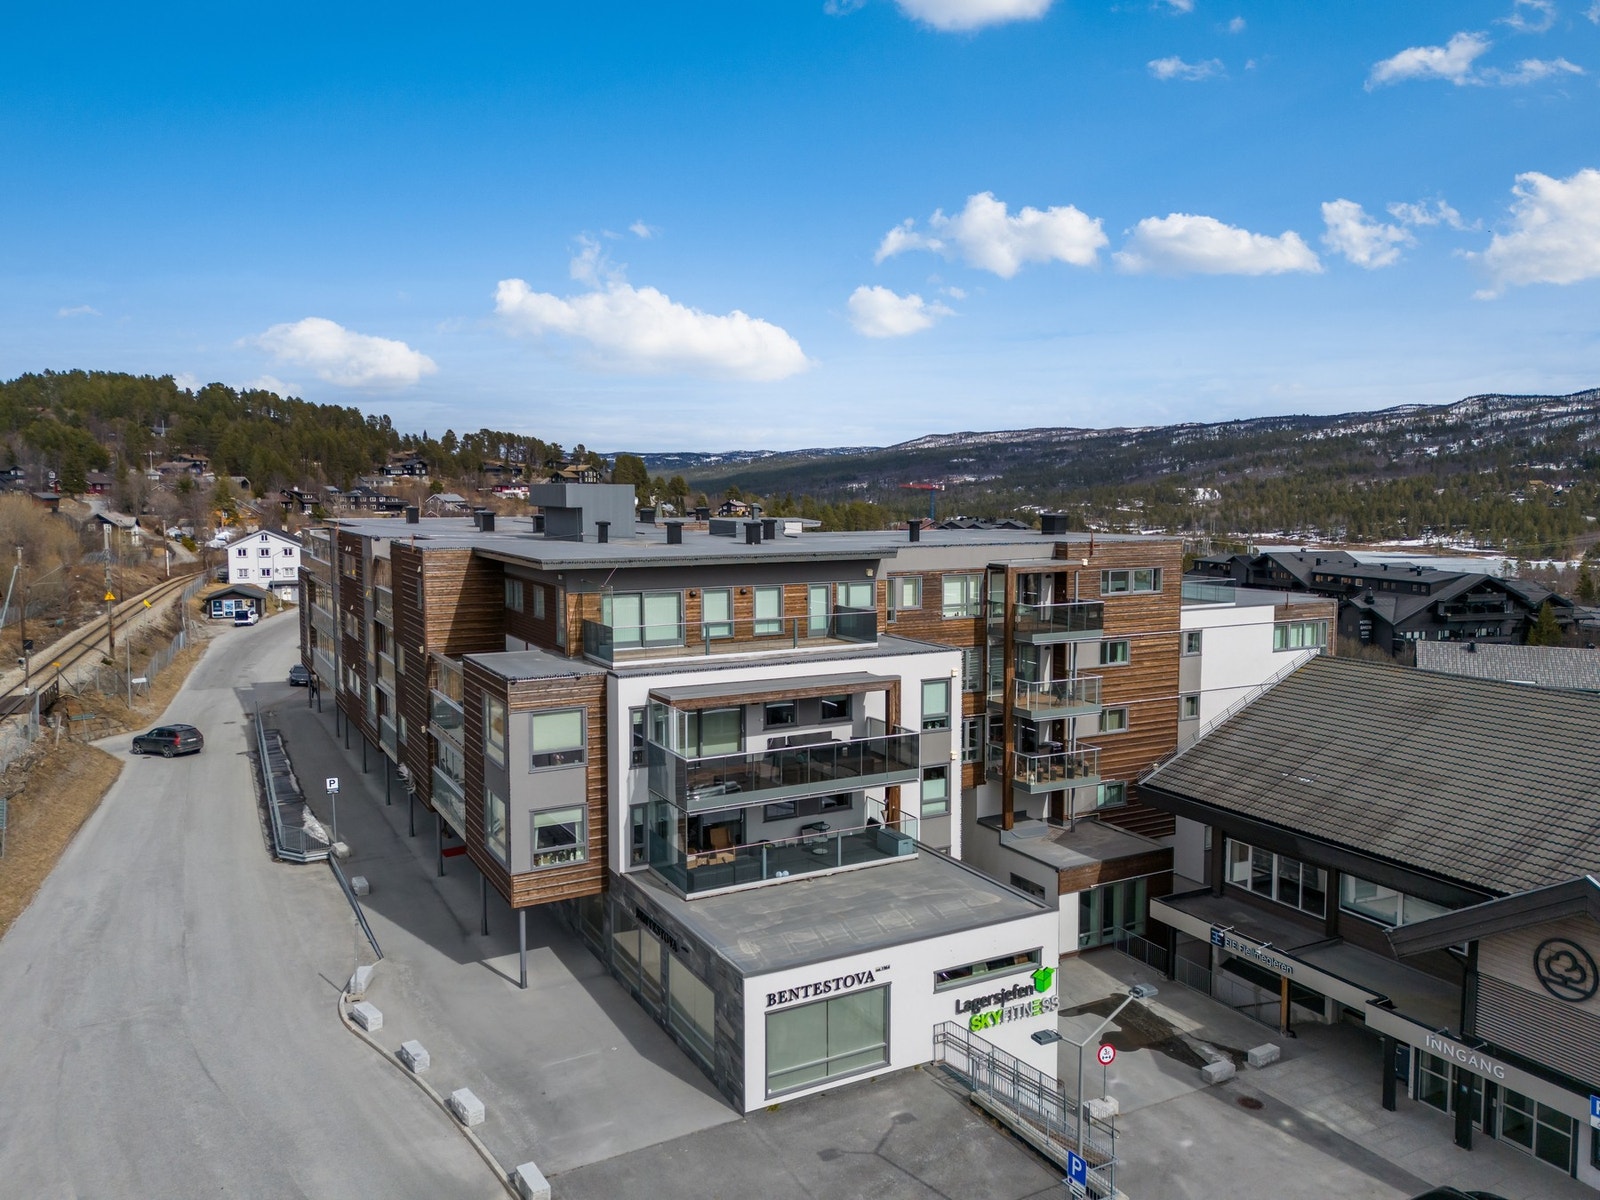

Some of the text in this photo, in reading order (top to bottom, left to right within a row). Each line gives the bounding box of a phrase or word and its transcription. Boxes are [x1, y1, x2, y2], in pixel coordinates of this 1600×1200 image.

[329, 779, 336, 787] P
[766, 970, 876, 1007] BENTESTOVA
[955, 983, 1034, 1016] Lagersjefen
[1425, 1034, 1505, 1079] INNGANG
[1071, 1156, 1083, 1176] P
